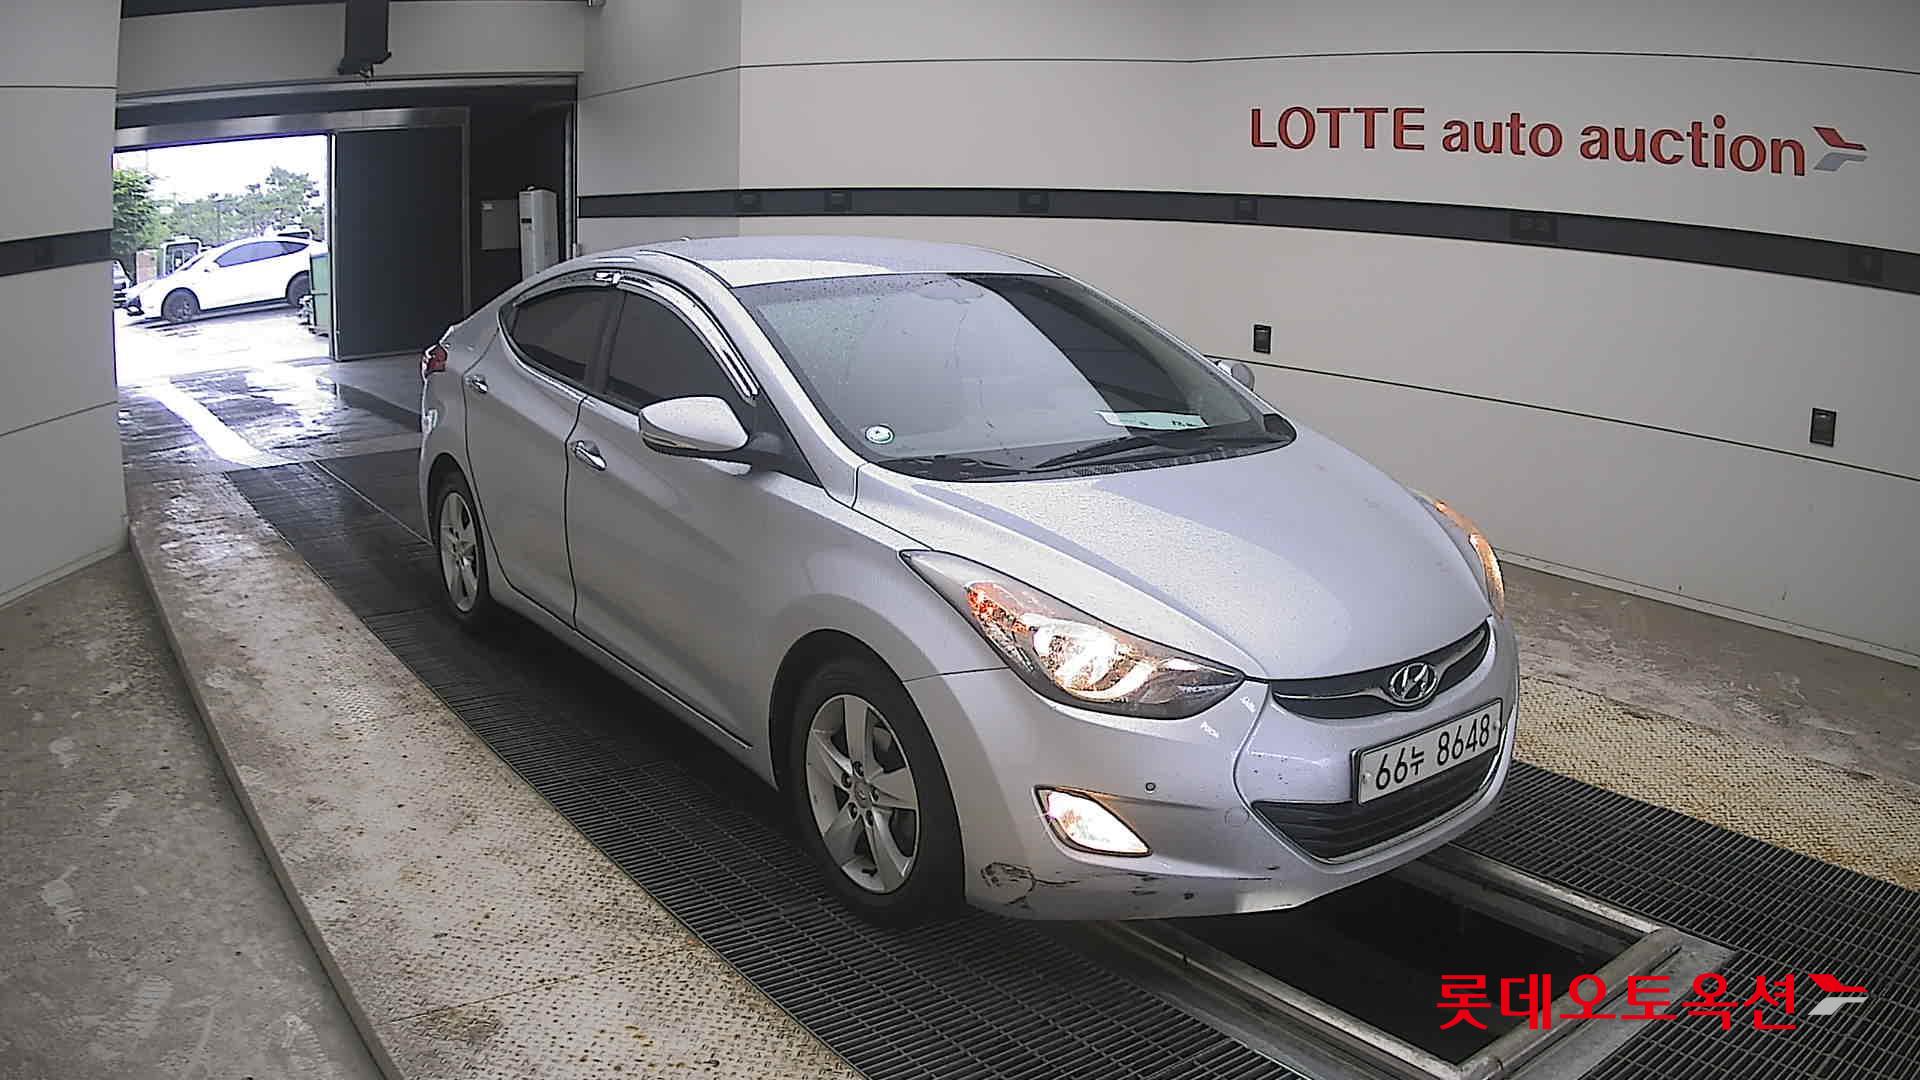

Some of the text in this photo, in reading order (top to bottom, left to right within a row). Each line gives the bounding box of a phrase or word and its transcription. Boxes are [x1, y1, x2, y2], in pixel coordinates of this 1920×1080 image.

[1250, 106, 1806, 176] LOTTE auto auction
[1375, 713, 1490, 790] 66누 8648
